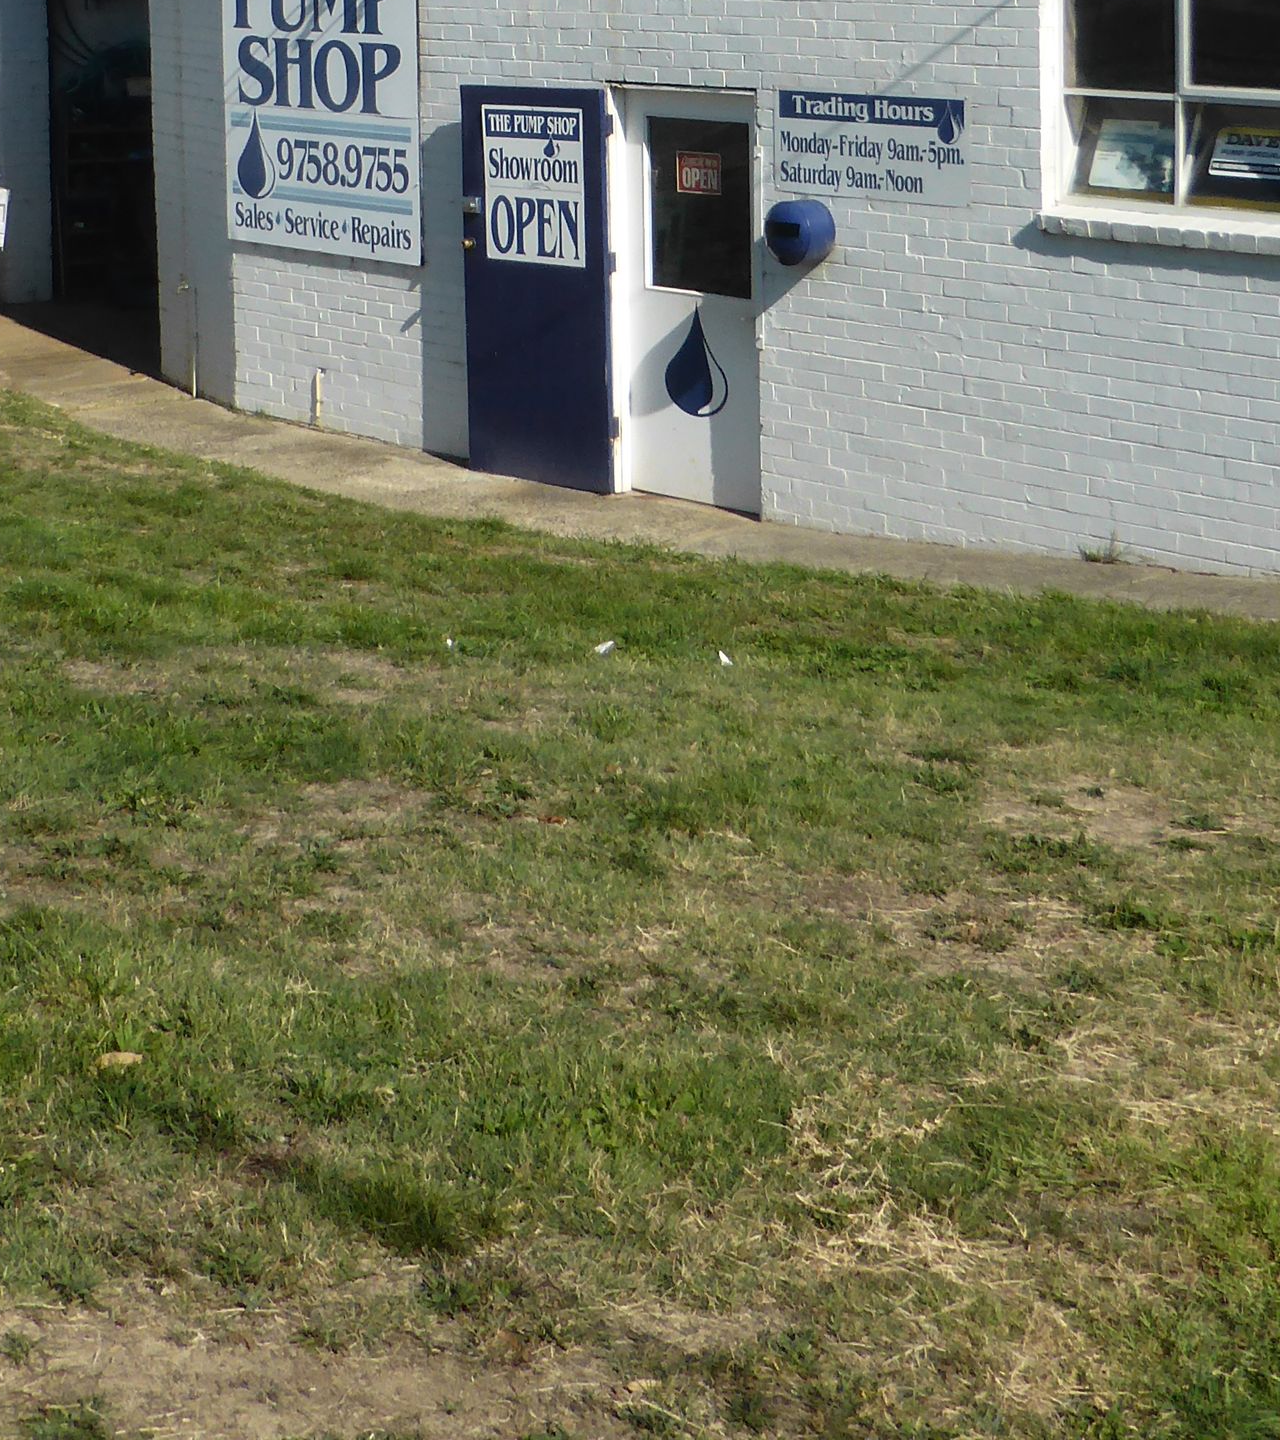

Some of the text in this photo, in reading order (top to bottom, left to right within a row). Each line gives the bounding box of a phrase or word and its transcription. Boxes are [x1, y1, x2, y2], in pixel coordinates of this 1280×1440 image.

[237, 34, 401, 114] SHOP
[488, 114, 577, 136] THE PUMP SHOP
[792, 95, 934, 123] Trading Hours
[780, 130, 883, 165] Monday-Friday
[276, 137, 409, 194] 9758.9755
[489, 148, 578, 184] Showroom
[682, 167, 718, 190] OPEN
[780, 161, 841, 192] Saturday
[235, 202, 411, 253] Sales Service Repairs
[491, 194, 580, 260] OPEN
